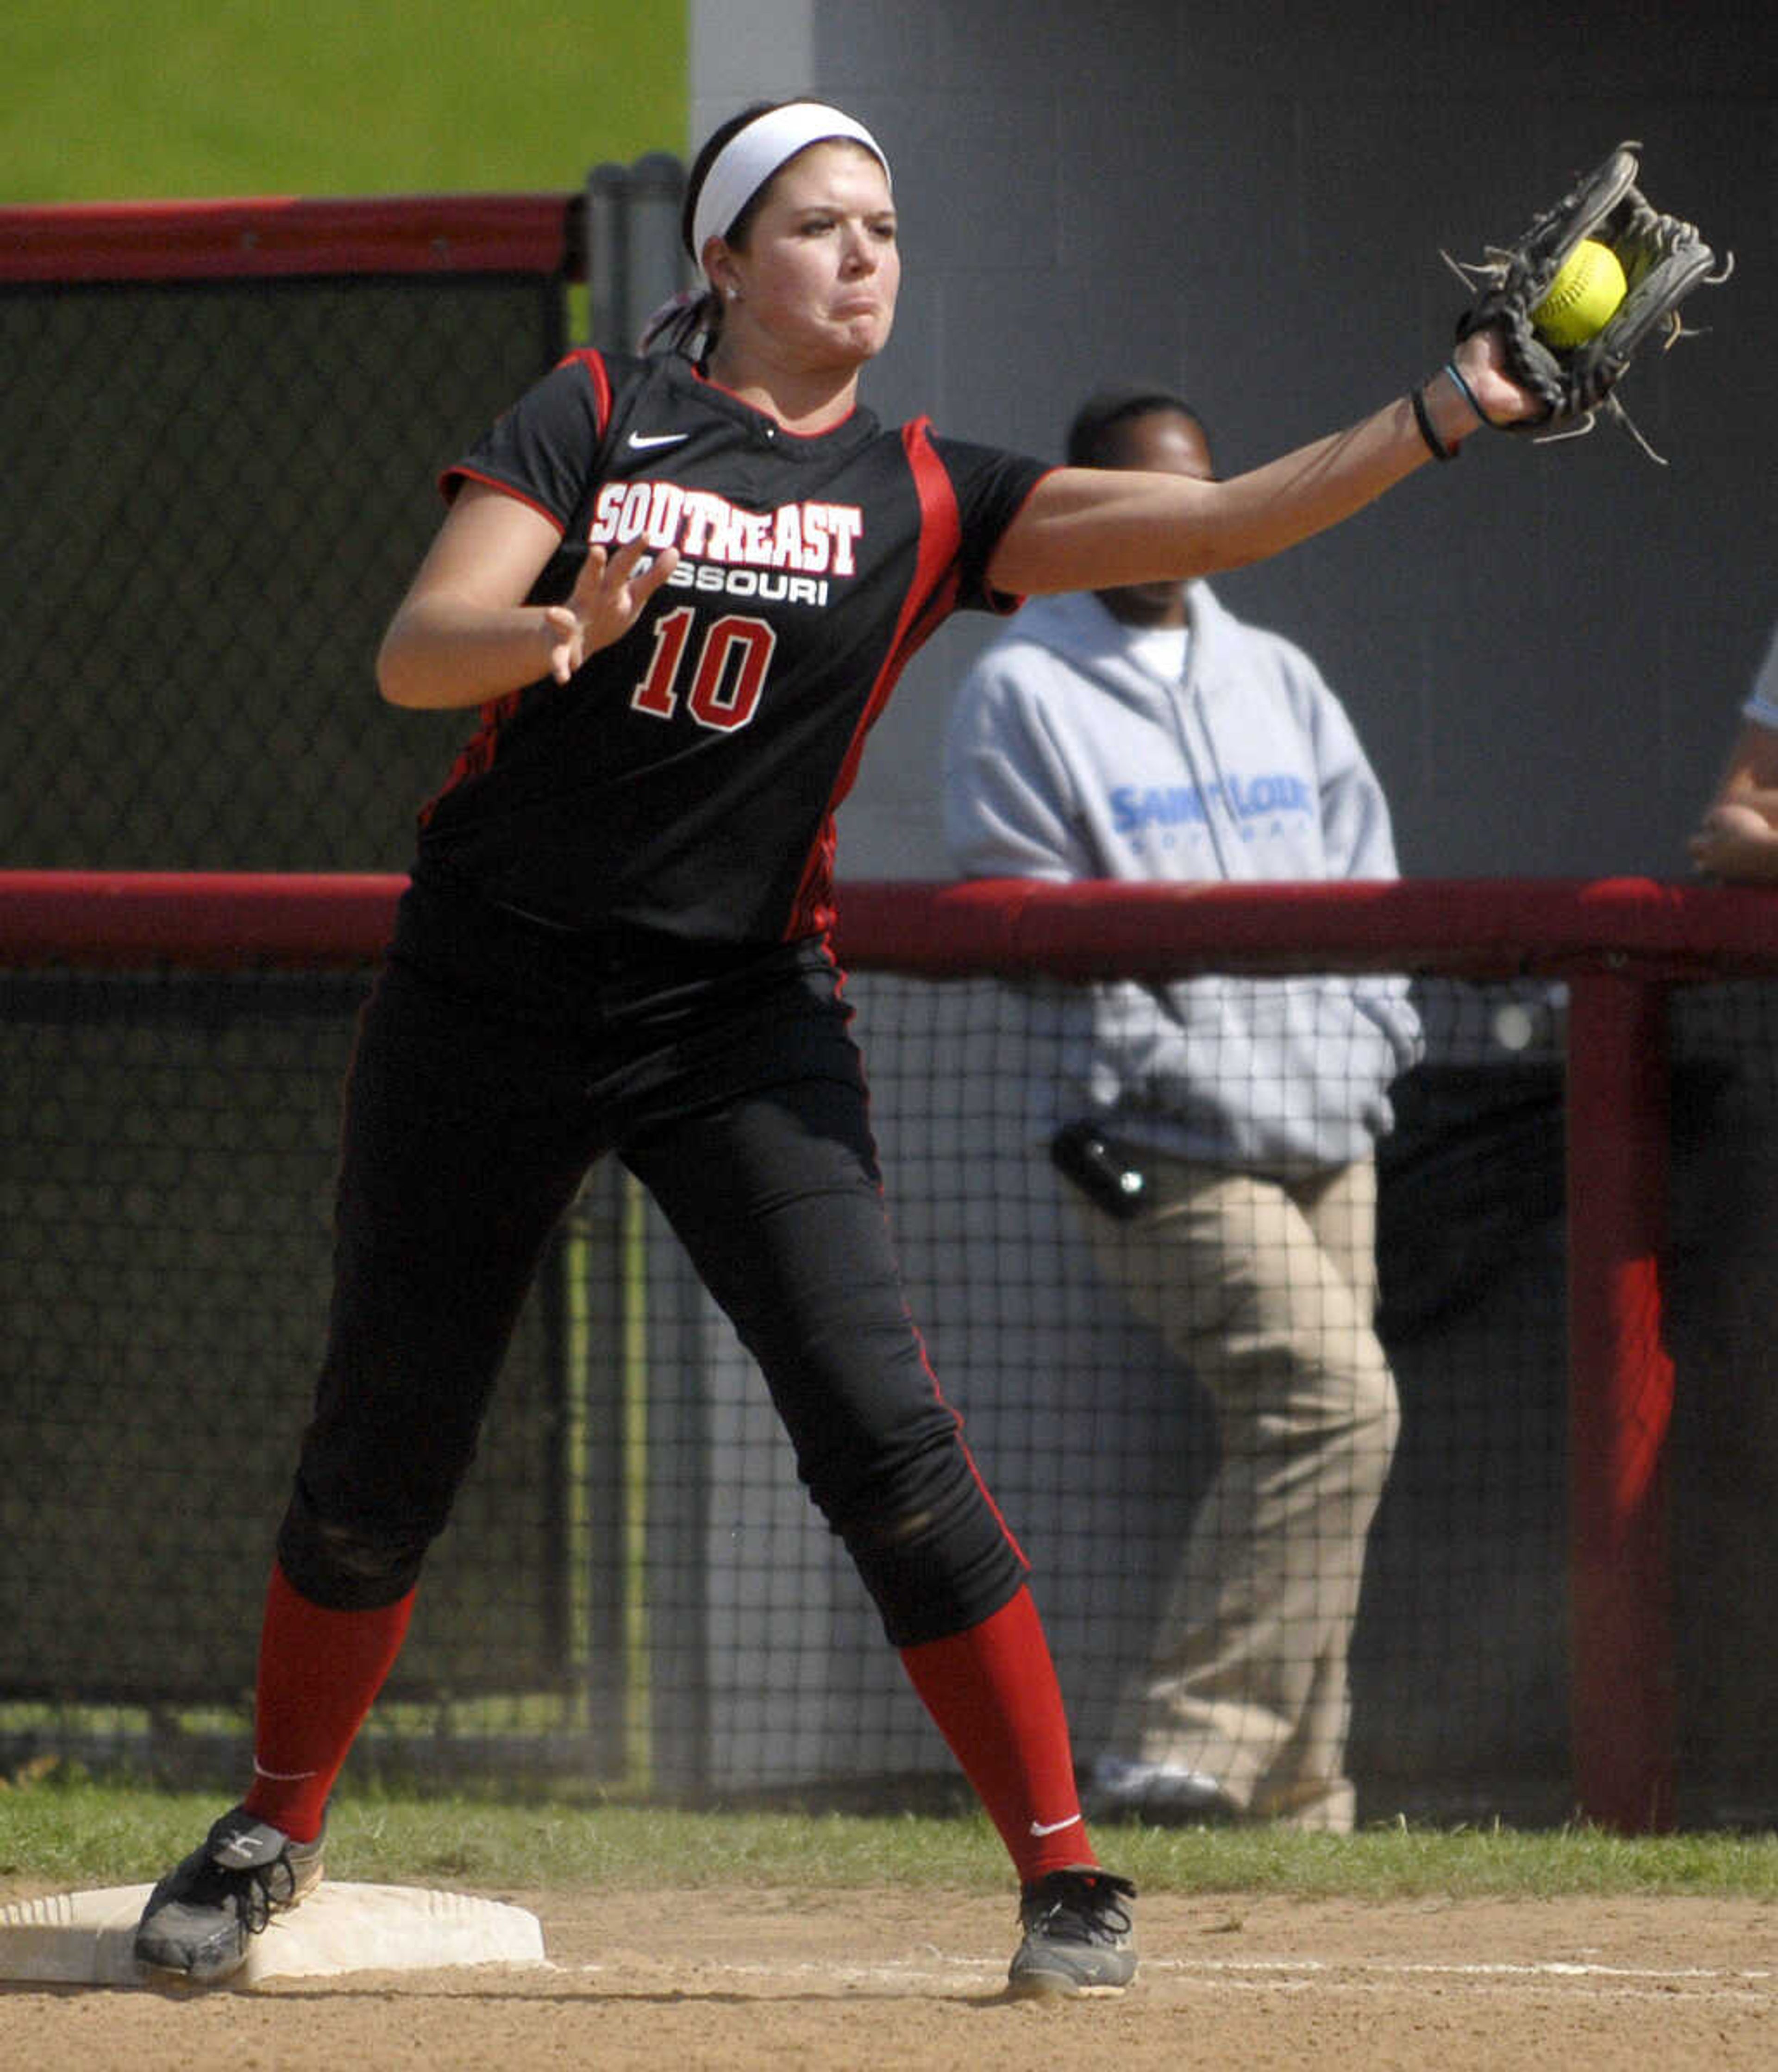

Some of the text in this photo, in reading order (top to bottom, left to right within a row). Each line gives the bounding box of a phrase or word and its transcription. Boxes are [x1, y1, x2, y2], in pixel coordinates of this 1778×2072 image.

[589, 480, 863, 577] SOUTHEAST
[629, 554, 829, 607] SSOURI
[630, 606, 777, 732] 10
